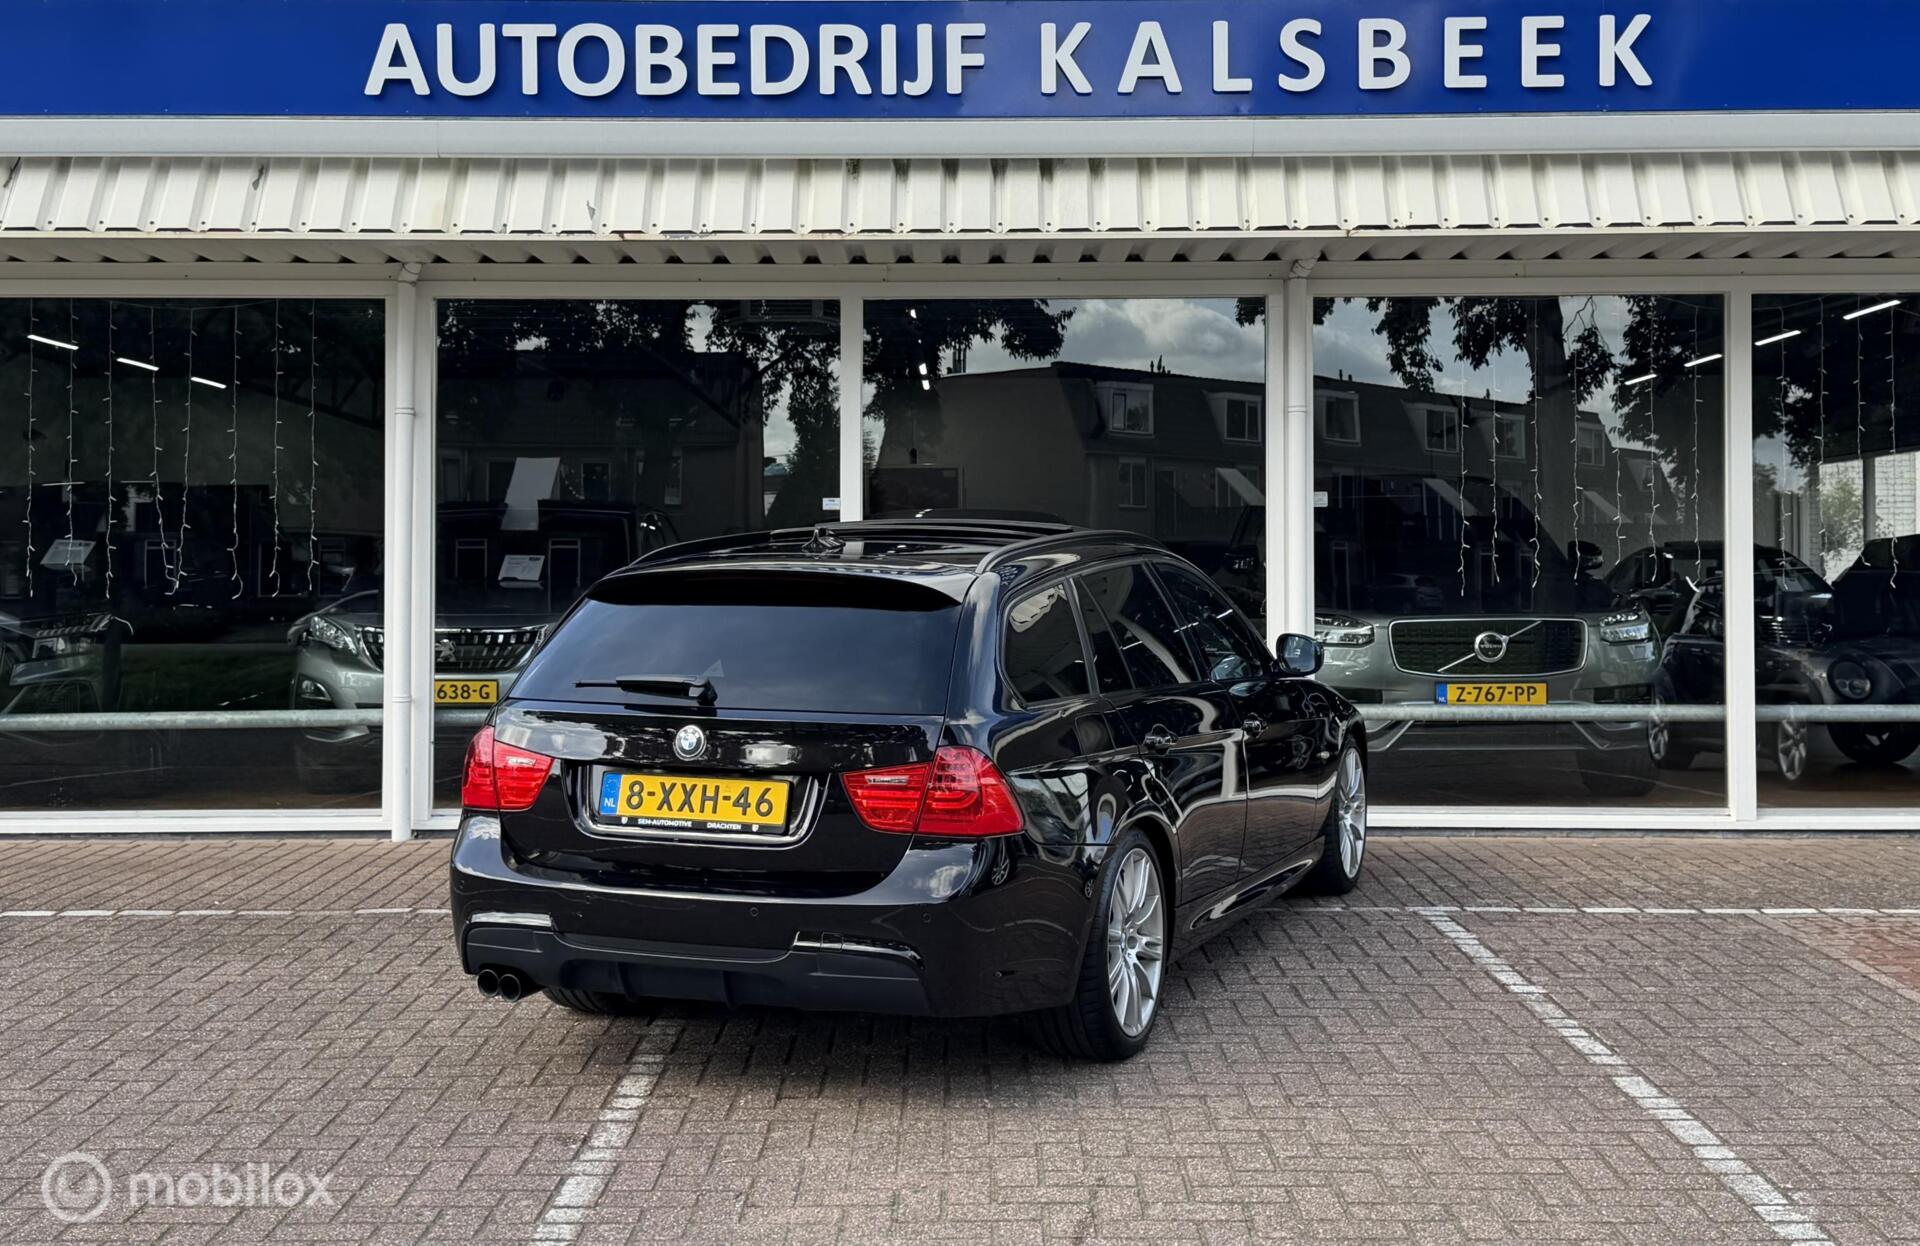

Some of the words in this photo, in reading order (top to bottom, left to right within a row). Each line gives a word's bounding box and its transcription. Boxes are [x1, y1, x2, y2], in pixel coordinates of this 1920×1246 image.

[364, 23, 986, 96] AUTOBEDRIJF
[1040, 13, 1653, 95] KALSBEEK
[1457, 686, 1537, 702] Z-767-PP
[604, 797, 616, 808] NL
[626, 780, 773, 817] 8-XXH-46
[707, 822, 742, 830] DRACHTEN
